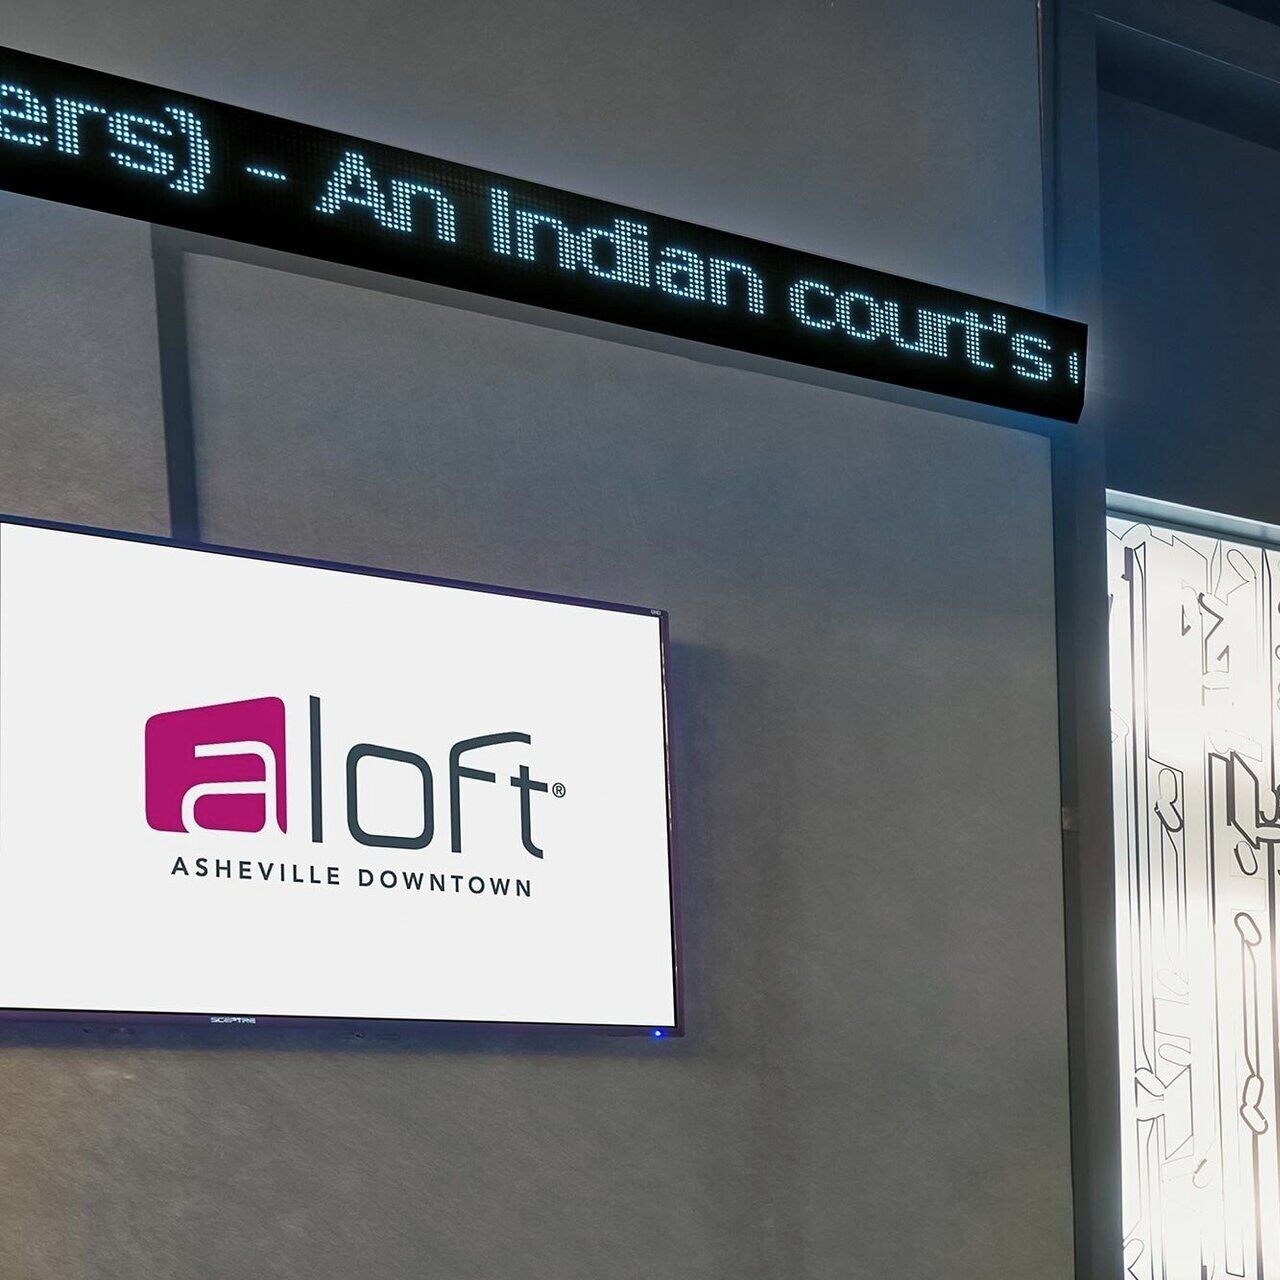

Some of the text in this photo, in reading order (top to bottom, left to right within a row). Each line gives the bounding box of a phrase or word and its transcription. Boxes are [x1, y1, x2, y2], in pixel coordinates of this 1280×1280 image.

[316, 152, 455, 242] An
[491, 188, 764, 314] Indian
[790, 280, 1052, 381] court's
[171, 857, 531, 897] ASHEVILLE DOWNTOWN
